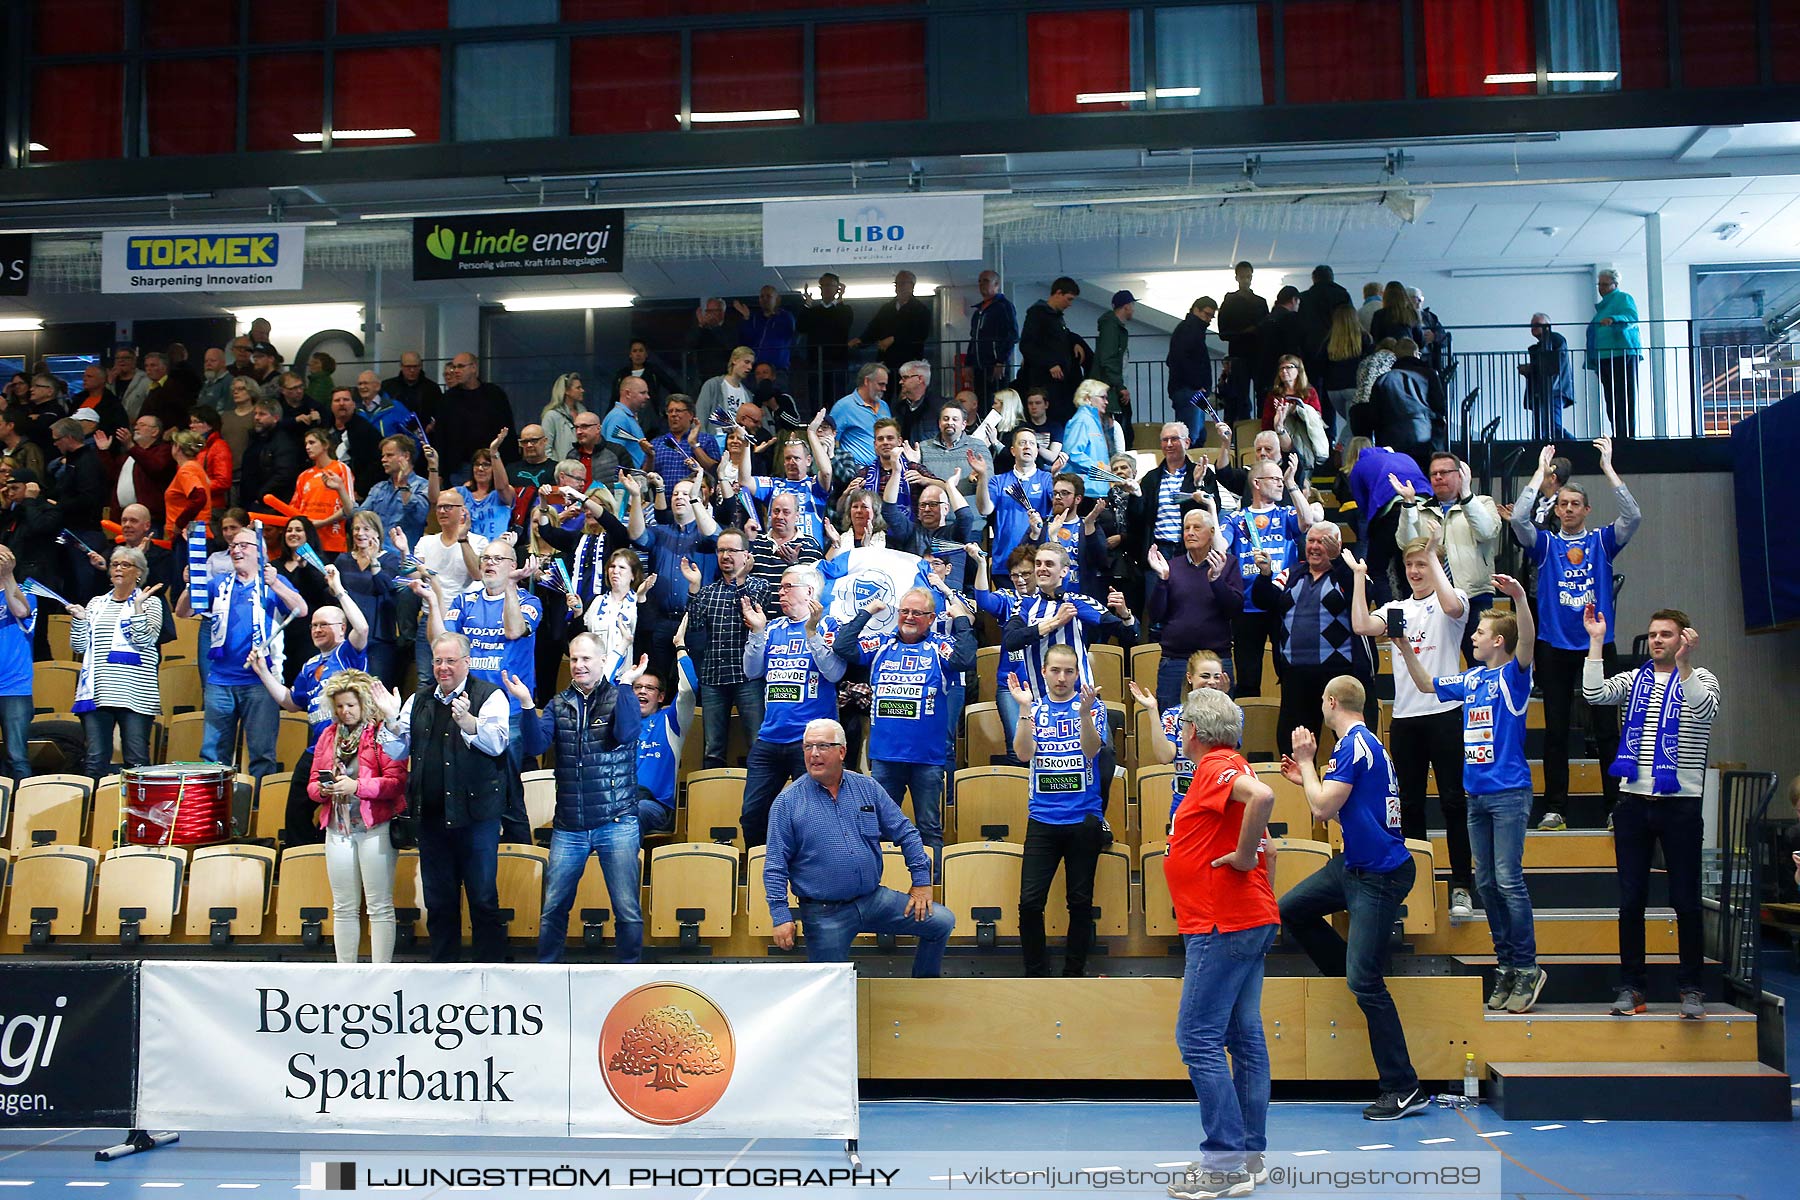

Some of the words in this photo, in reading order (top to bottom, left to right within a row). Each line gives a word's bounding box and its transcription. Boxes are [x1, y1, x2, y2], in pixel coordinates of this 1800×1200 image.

[459, 228, 529, 255] Linde
[532, 225, 611, 256] energi
[131, 237, 273, 267] TORMEK
[813, 246, 832, 254] Hem
[836, 245, 851, 254] för
[854, 245, 877, 253] alla.
[881, 244, 903, 252] Hela
[907, 243, 934, 251] livet.
[458, 261, 494, 270] Personlig
[495, 260, 523, 269] värme.
[524, 258, 543, 268] Kraft
[544, 257, 562, 266] från
[562, 255, 608, 268] Bergslagen.
[131, 275, 203, 288] Sharpening
[206, 274, 273, 286] Innovation
[462, 626, 505, 637] VOLVO
[769, 659, 807, 667] VOLVO
[881, 674, 924, 683] VOLVO
[880, 701, 914, 710] GRÖNSAKS
[887, 707, 909, 715] HUSET
[1039, 712, 1049, 727] 6
[1037, 742, 1081, 751] VOLVO
[1050, 782, 1073, 790] HUSET
[255, 988, 544, 1050] Bergslagens
[285, 1052, 515, 1114] Sparbank
